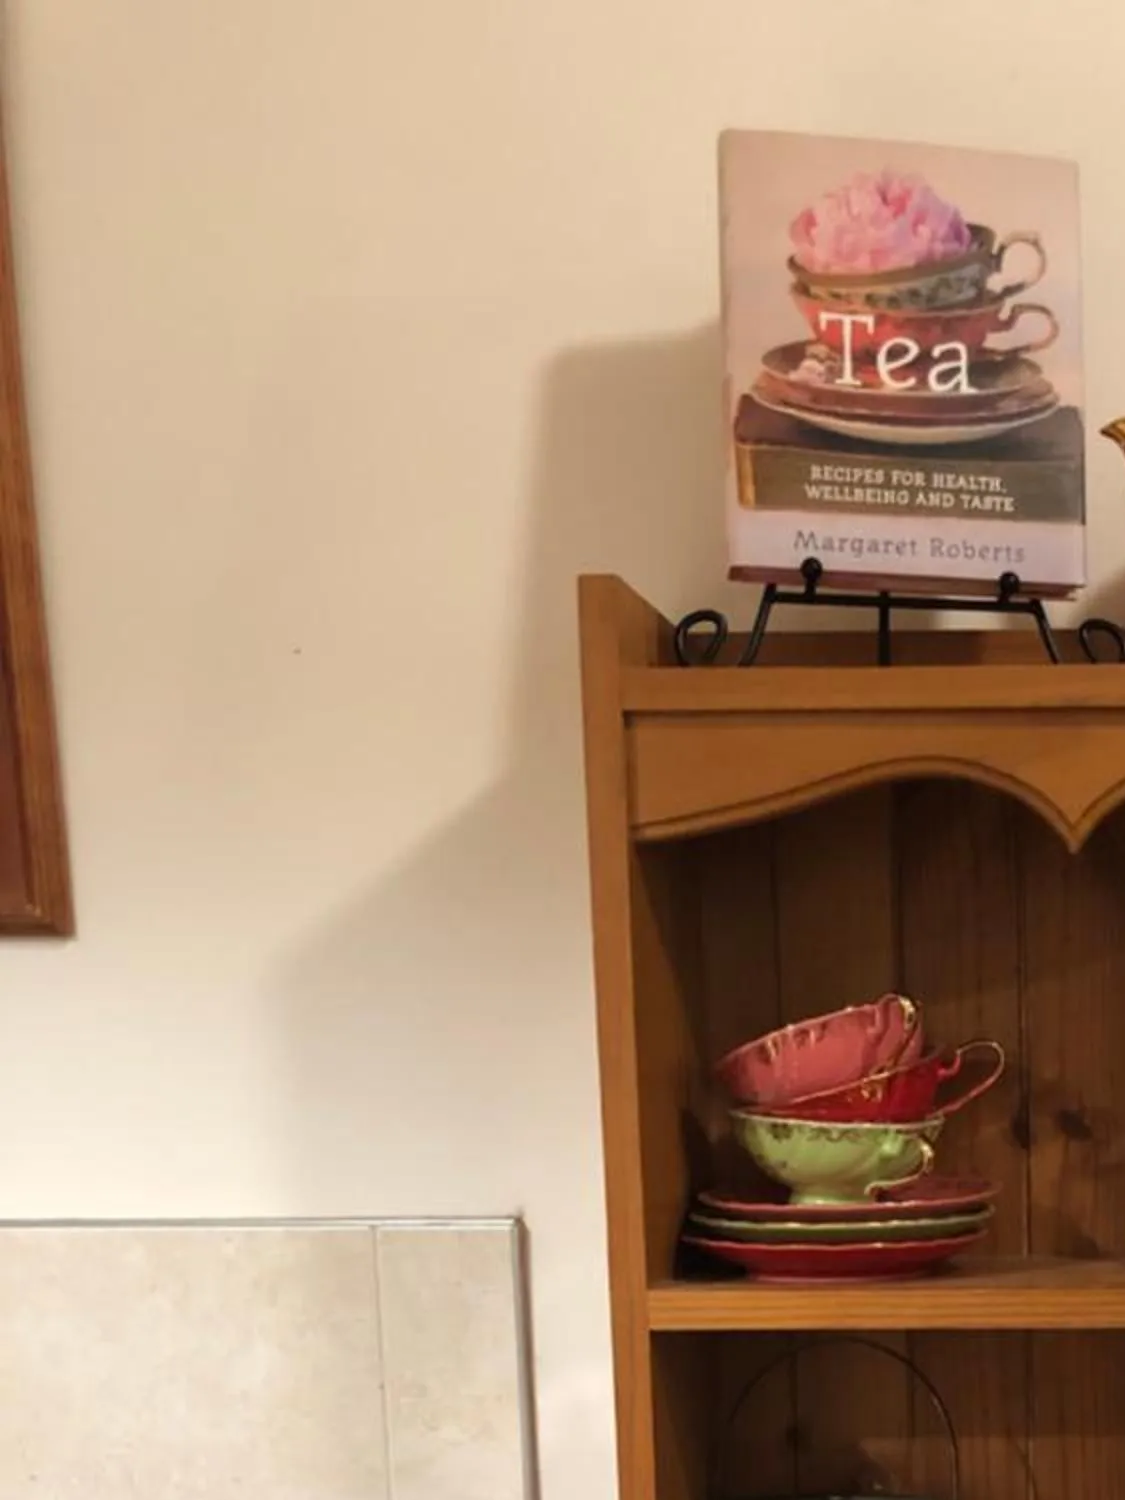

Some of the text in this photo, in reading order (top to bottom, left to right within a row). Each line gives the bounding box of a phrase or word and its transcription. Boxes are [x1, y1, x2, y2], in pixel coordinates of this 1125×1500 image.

[819, 311, 978, 395] Tea
[810, 464, 885, 484] RECIPES
[891, 470, 927, 487] FOR
[805, 484, 1015, 512] WELLBEING AND TASTE
[793, 530, 1026, 563] Margaret Roberts
